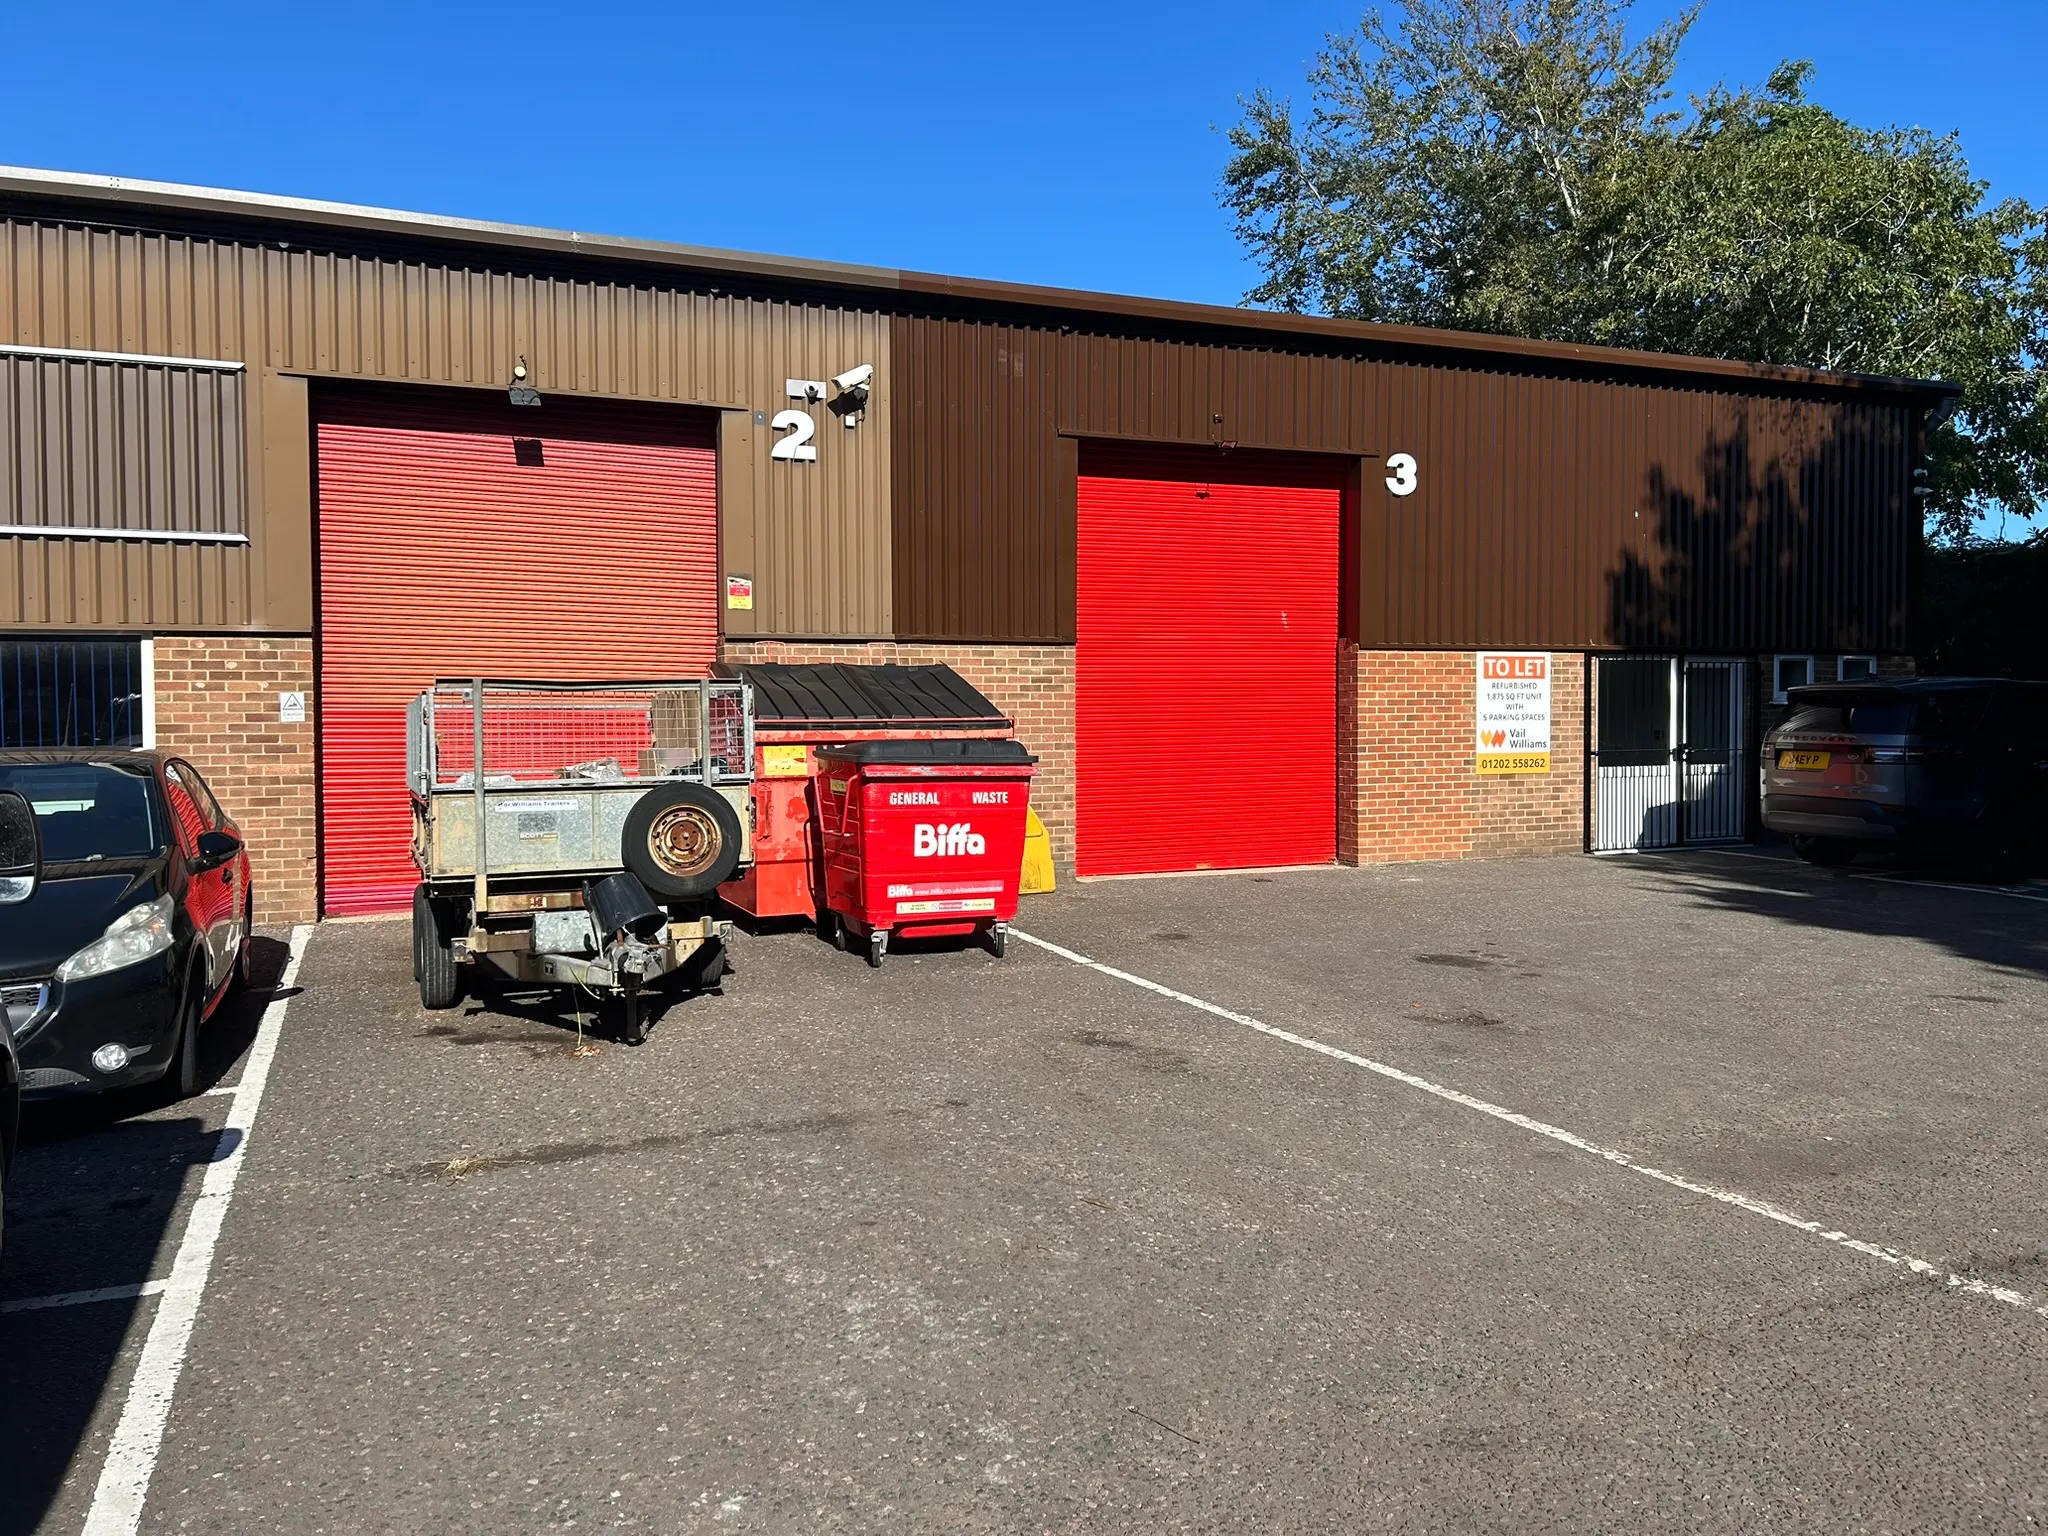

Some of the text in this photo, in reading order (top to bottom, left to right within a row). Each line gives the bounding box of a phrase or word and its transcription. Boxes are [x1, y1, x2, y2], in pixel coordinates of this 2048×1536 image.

[770, 409, 817, 460] 2
[1385, 452, 1417, 496] 3
[1485, 658, 1545, 677] TO LET
[1491, 682, 1537, 690] REFURBISHED
[1487, 693, 1505, 701] 1,875
[1505, 693, 1516, 701] SQ
[1505, 703, 1524, 711] WITH
[1509, 728, 1526, 738] Vail
[1509, 739, 1547, 749] Williams
[1481, 758, 1546, 769] 01202 558262
[889, 791, 1009, 806] GENERAL WASTE
[914, 823, 986, 857] Biffa
[887, 884, 914, 898] Biffa
